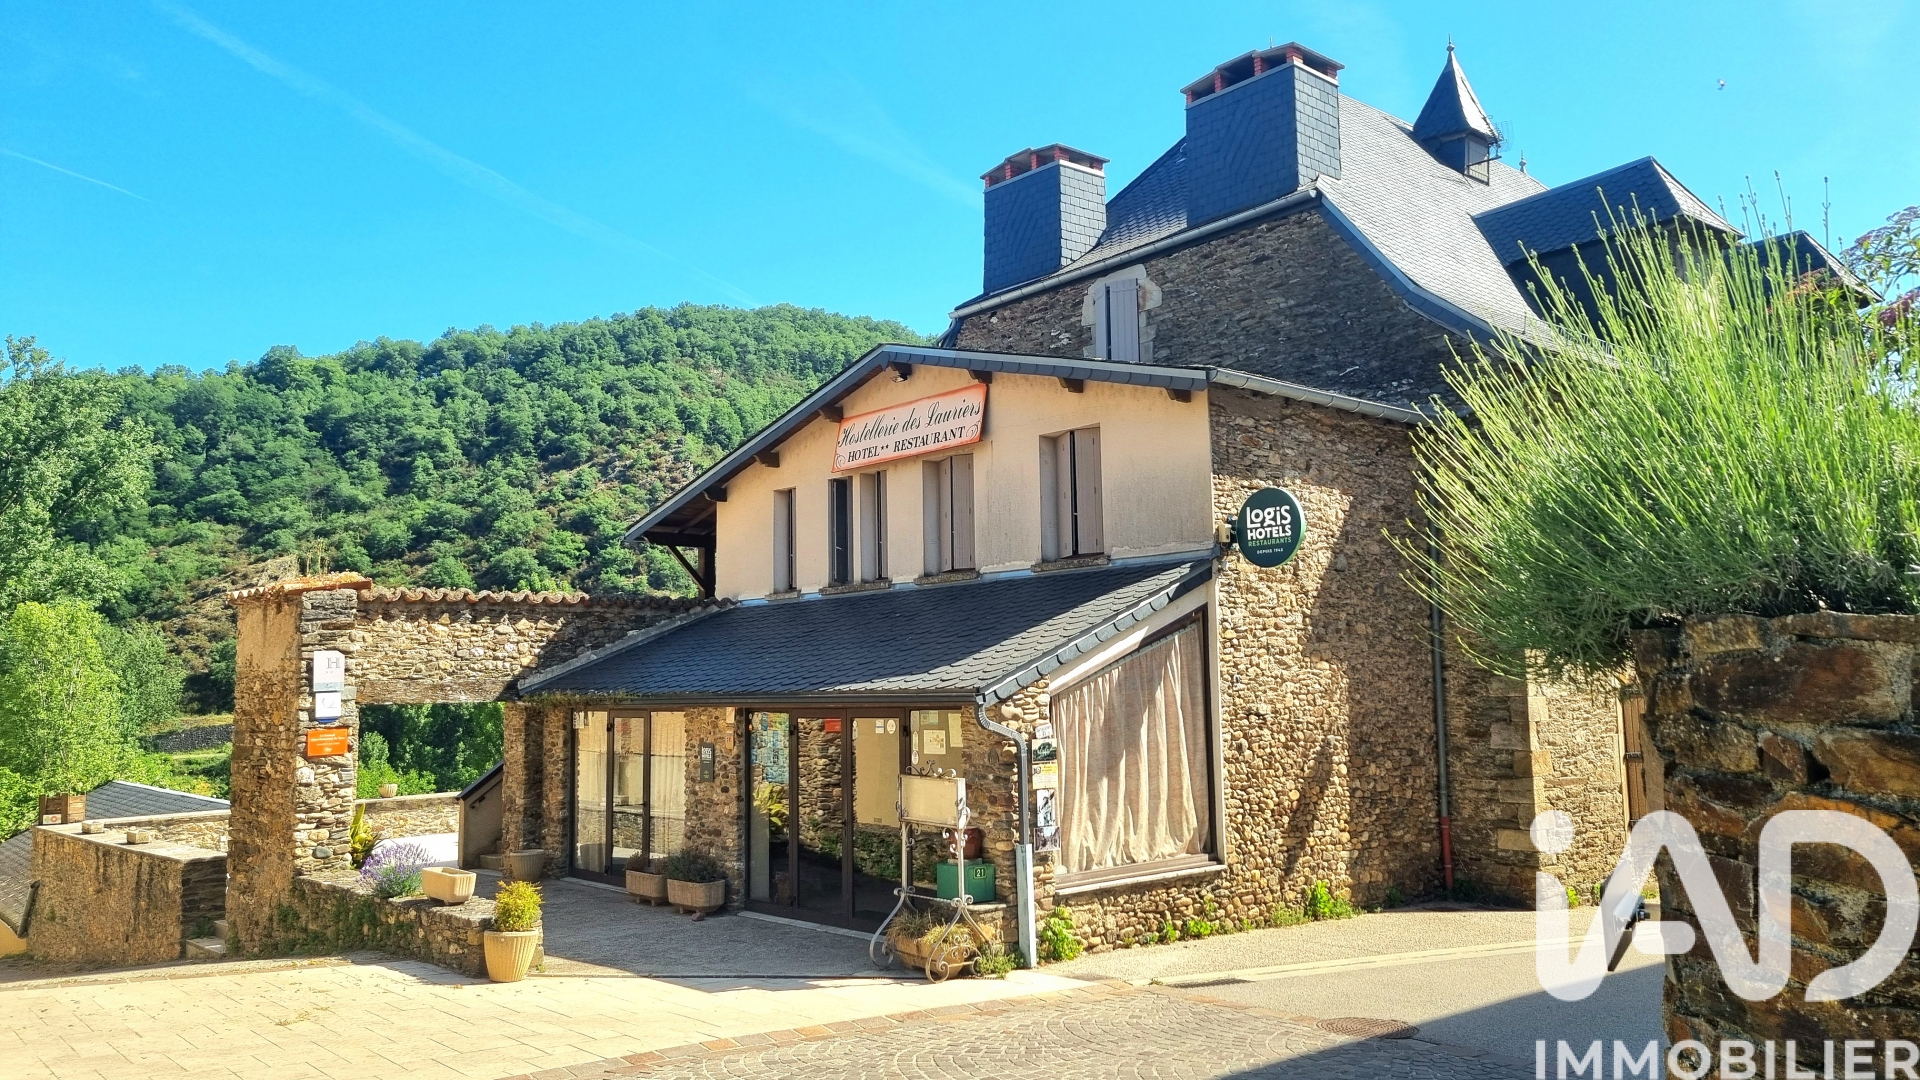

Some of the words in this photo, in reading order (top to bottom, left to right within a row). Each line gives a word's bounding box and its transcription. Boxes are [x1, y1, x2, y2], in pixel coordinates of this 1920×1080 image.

[838, 414, 899, 447] Hostellerie
[902, 407, 921, 433] des
[925, 399, 981, 429] Lauriers
[893, 425, 965, 453] RESTAURANT
[1247, 525, 1292, 540] HOTELS
[1248, 537, 1292, 547] RESTAURANTS
[327, 656, 341, 669] H
[976, 868, 984, 877] 21
